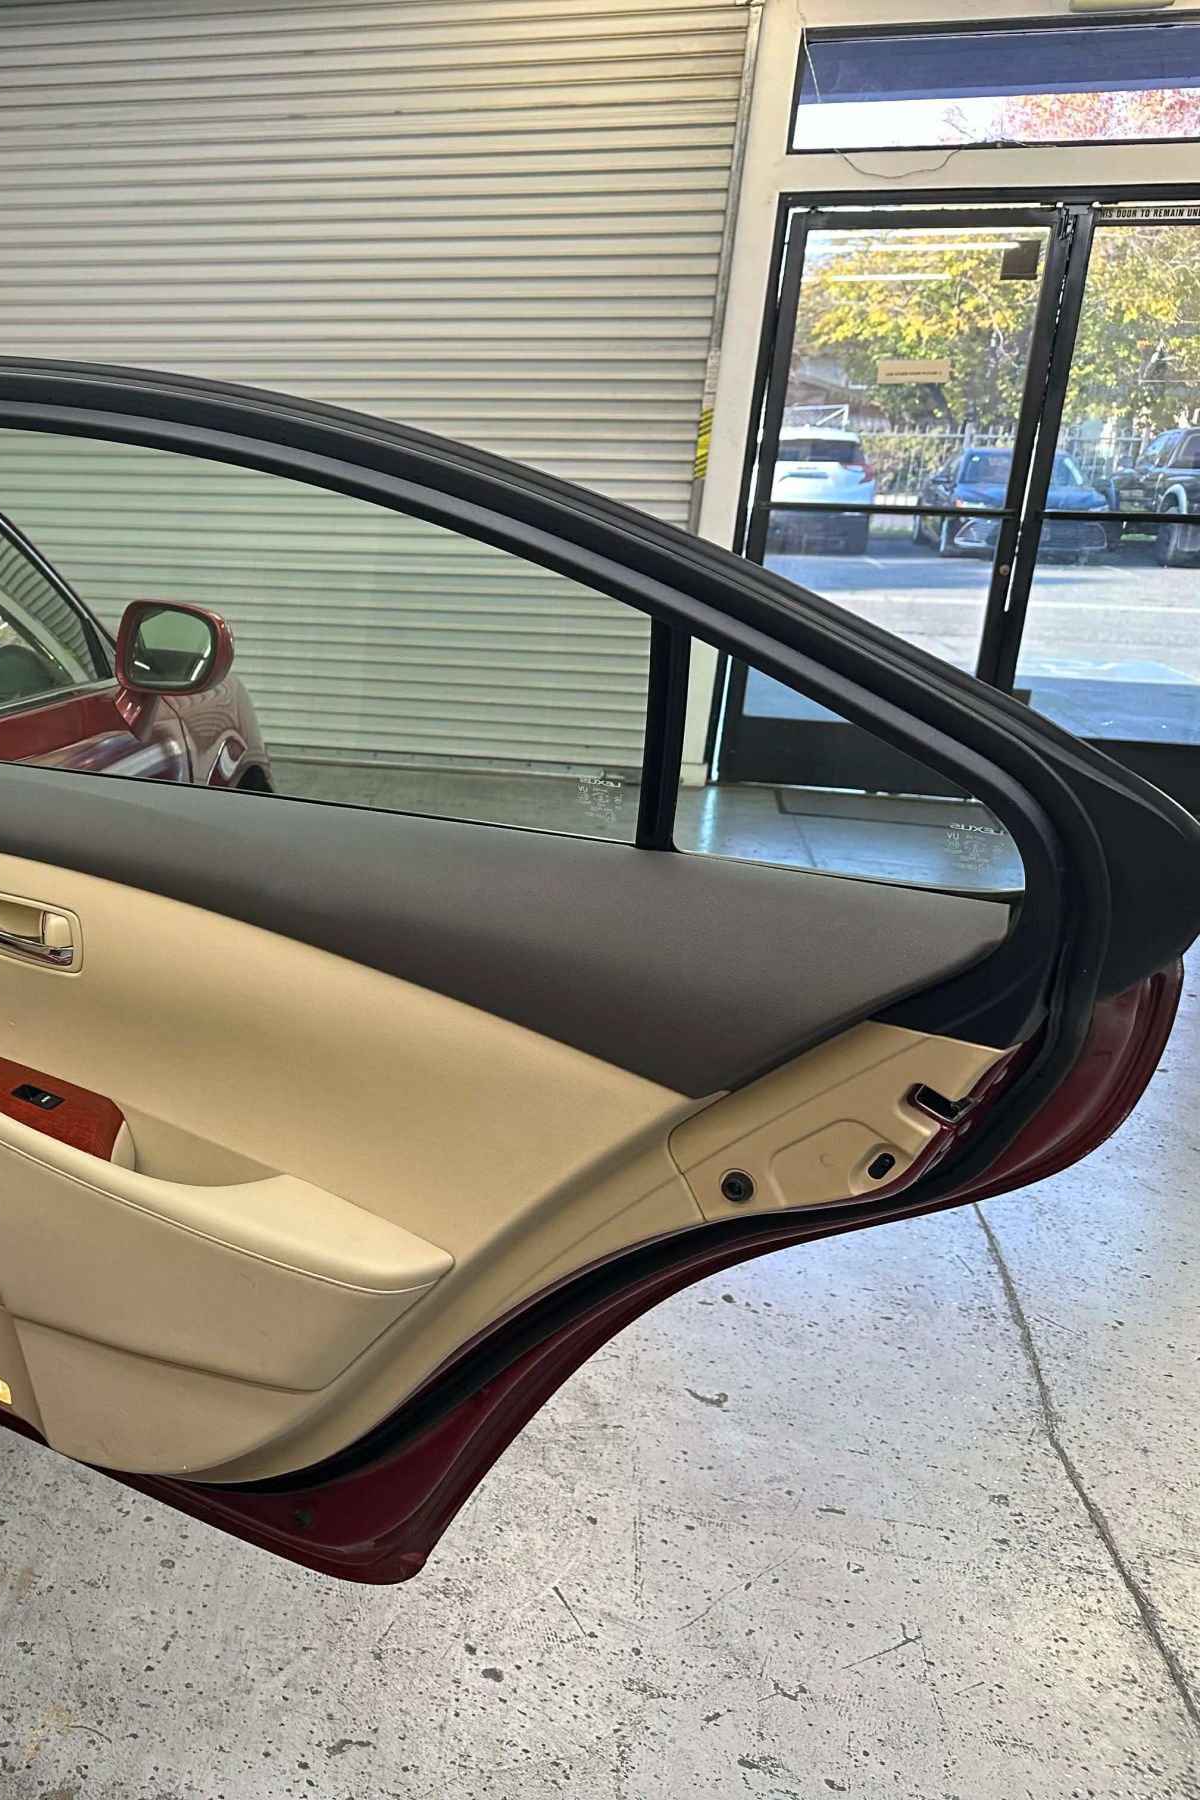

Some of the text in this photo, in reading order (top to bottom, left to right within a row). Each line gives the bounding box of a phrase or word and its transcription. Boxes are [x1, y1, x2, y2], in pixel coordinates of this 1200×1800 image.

[1116, 209, 1137, 218] DOOR
[1141, 208, 1151, 217] TO
[1153, 208, 1184, 217] REMAIN
